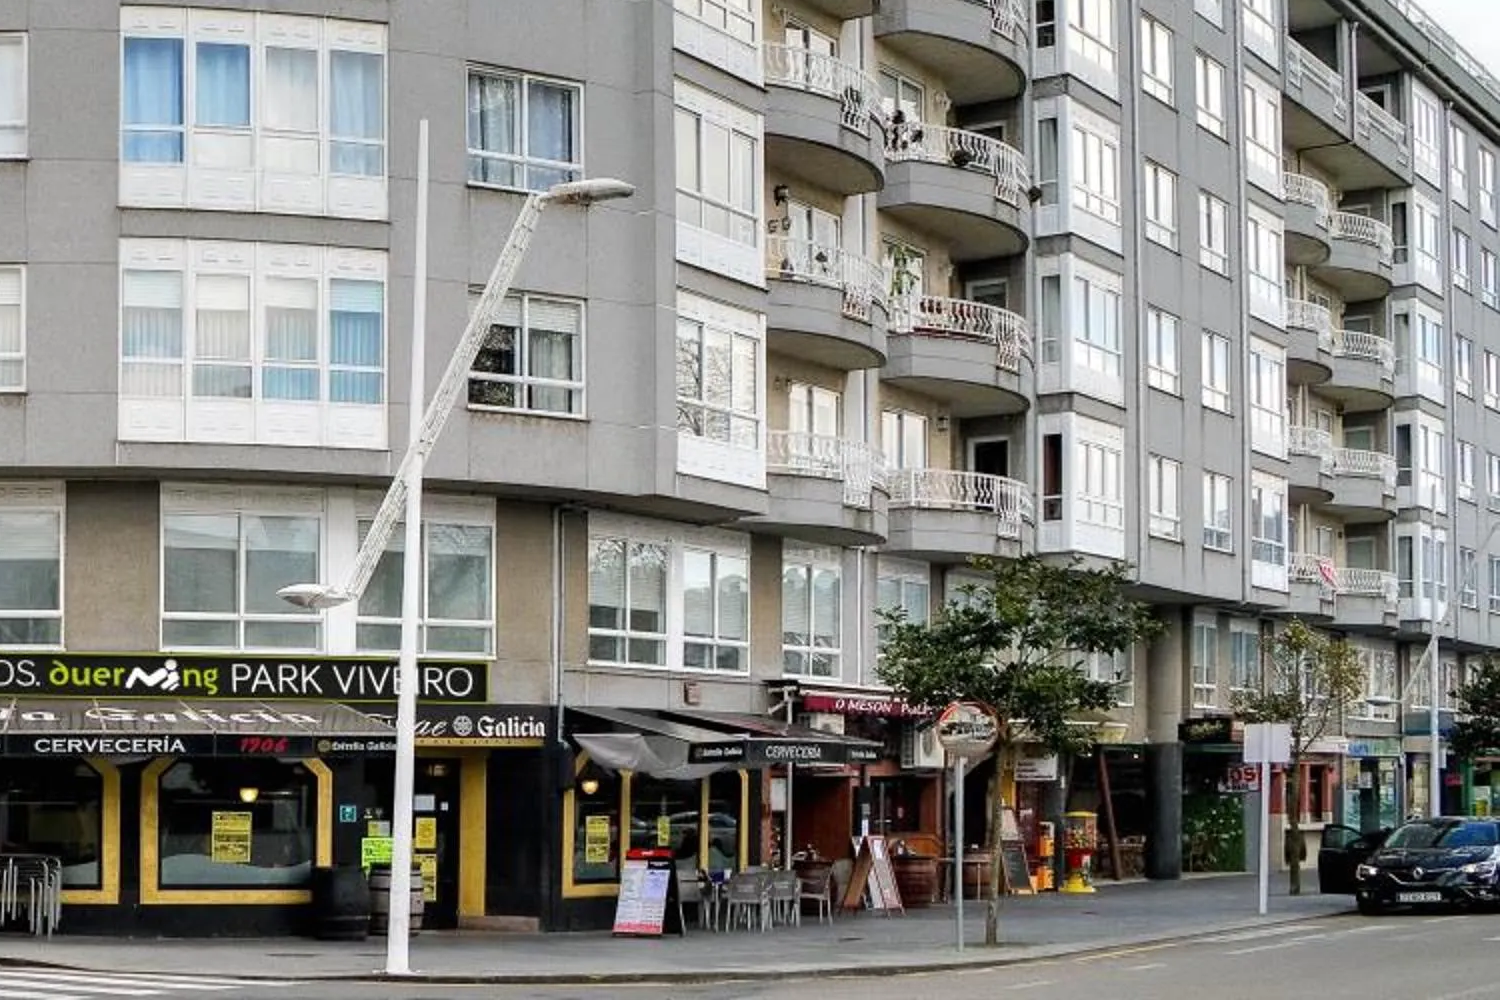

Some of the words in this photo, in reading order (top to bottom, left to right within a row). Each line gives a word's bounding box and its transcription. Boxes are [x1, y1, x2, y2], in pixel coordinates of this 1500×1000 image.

[231, 664, 323, 694] PARK
[332, 666, 474, 697] VIVEIRO
[477, 715, 547, 737] Galicia
[34, 735, 186, 753] CERVECERÍA
[240, 736, 288, 753] 1906
